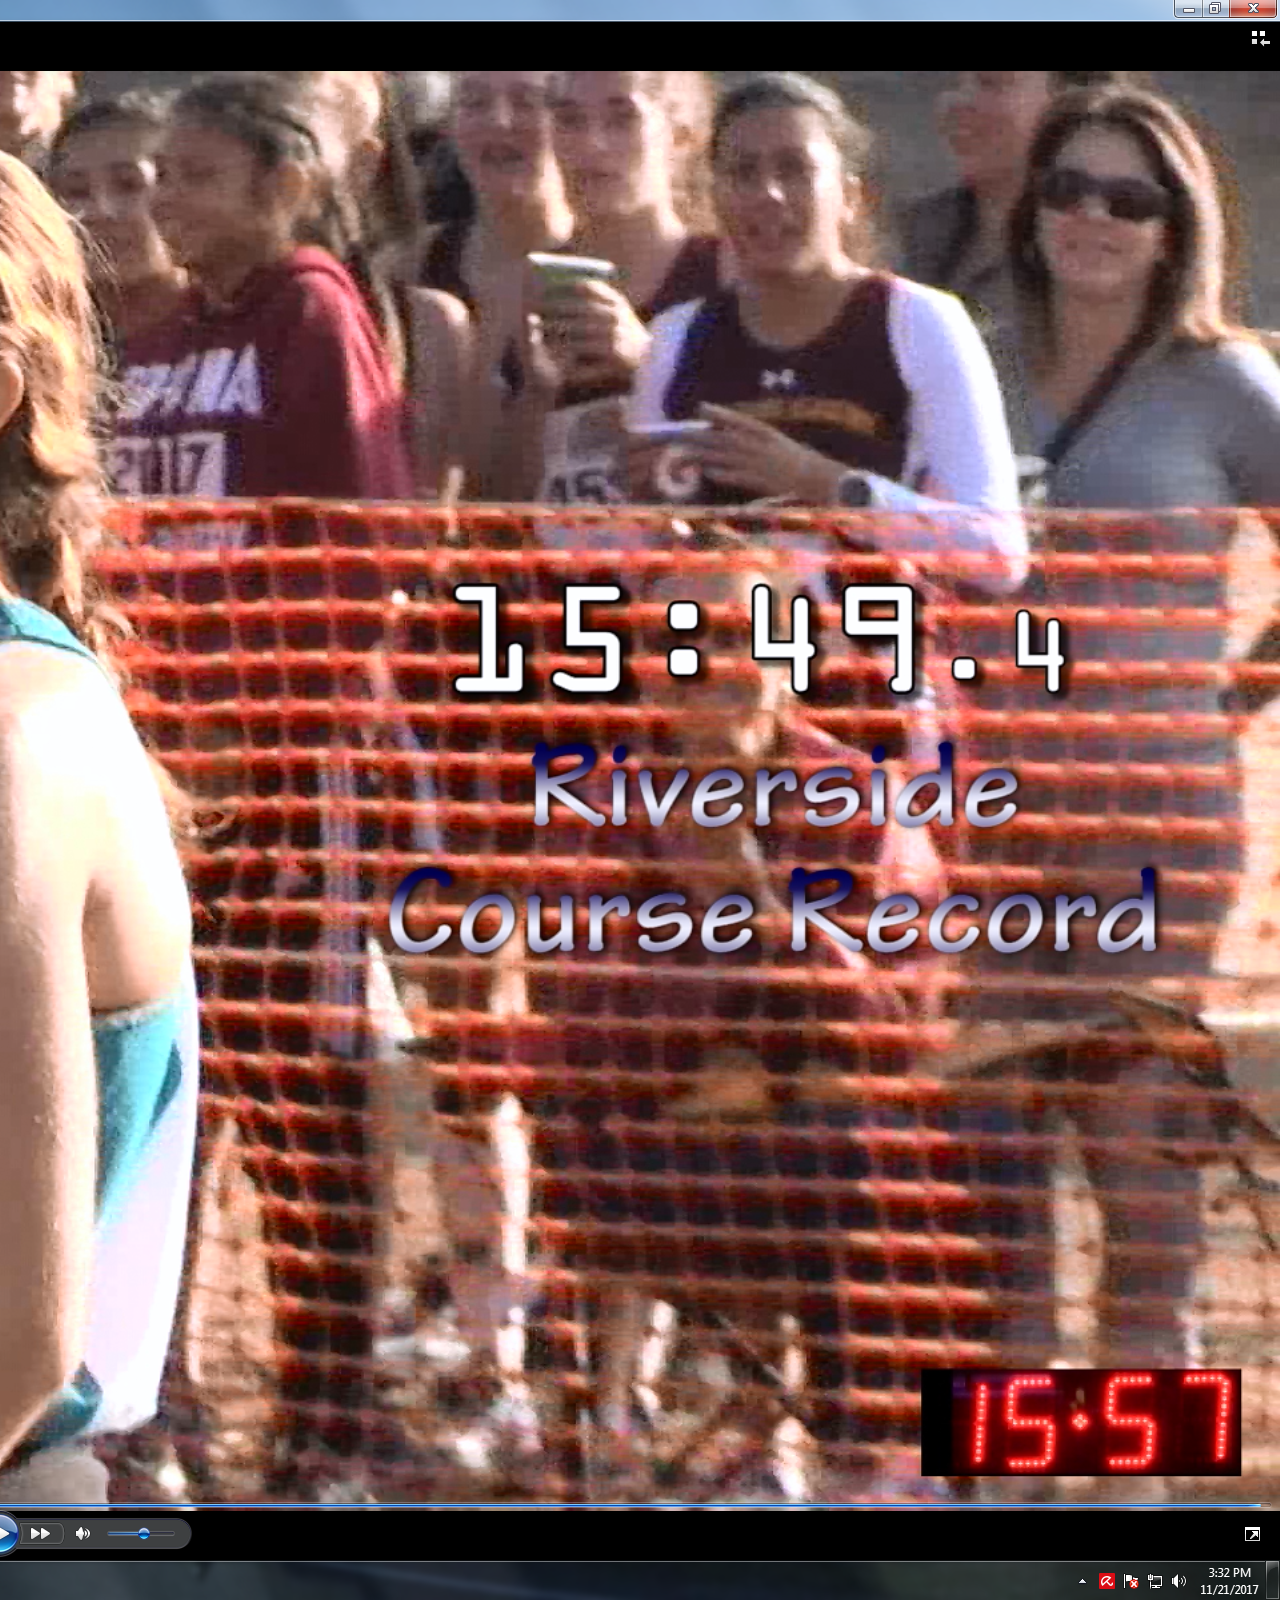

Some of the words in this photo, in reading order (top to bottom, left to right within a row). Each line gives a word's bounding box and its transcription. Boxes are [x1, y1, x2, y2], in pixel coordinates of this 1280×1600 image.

[1208, 1567, 1231, 1579] 3:32
[1233, 1567, 1252, 1579] PM
[1200, 1584, 1259, 1597] 11/21/2017
